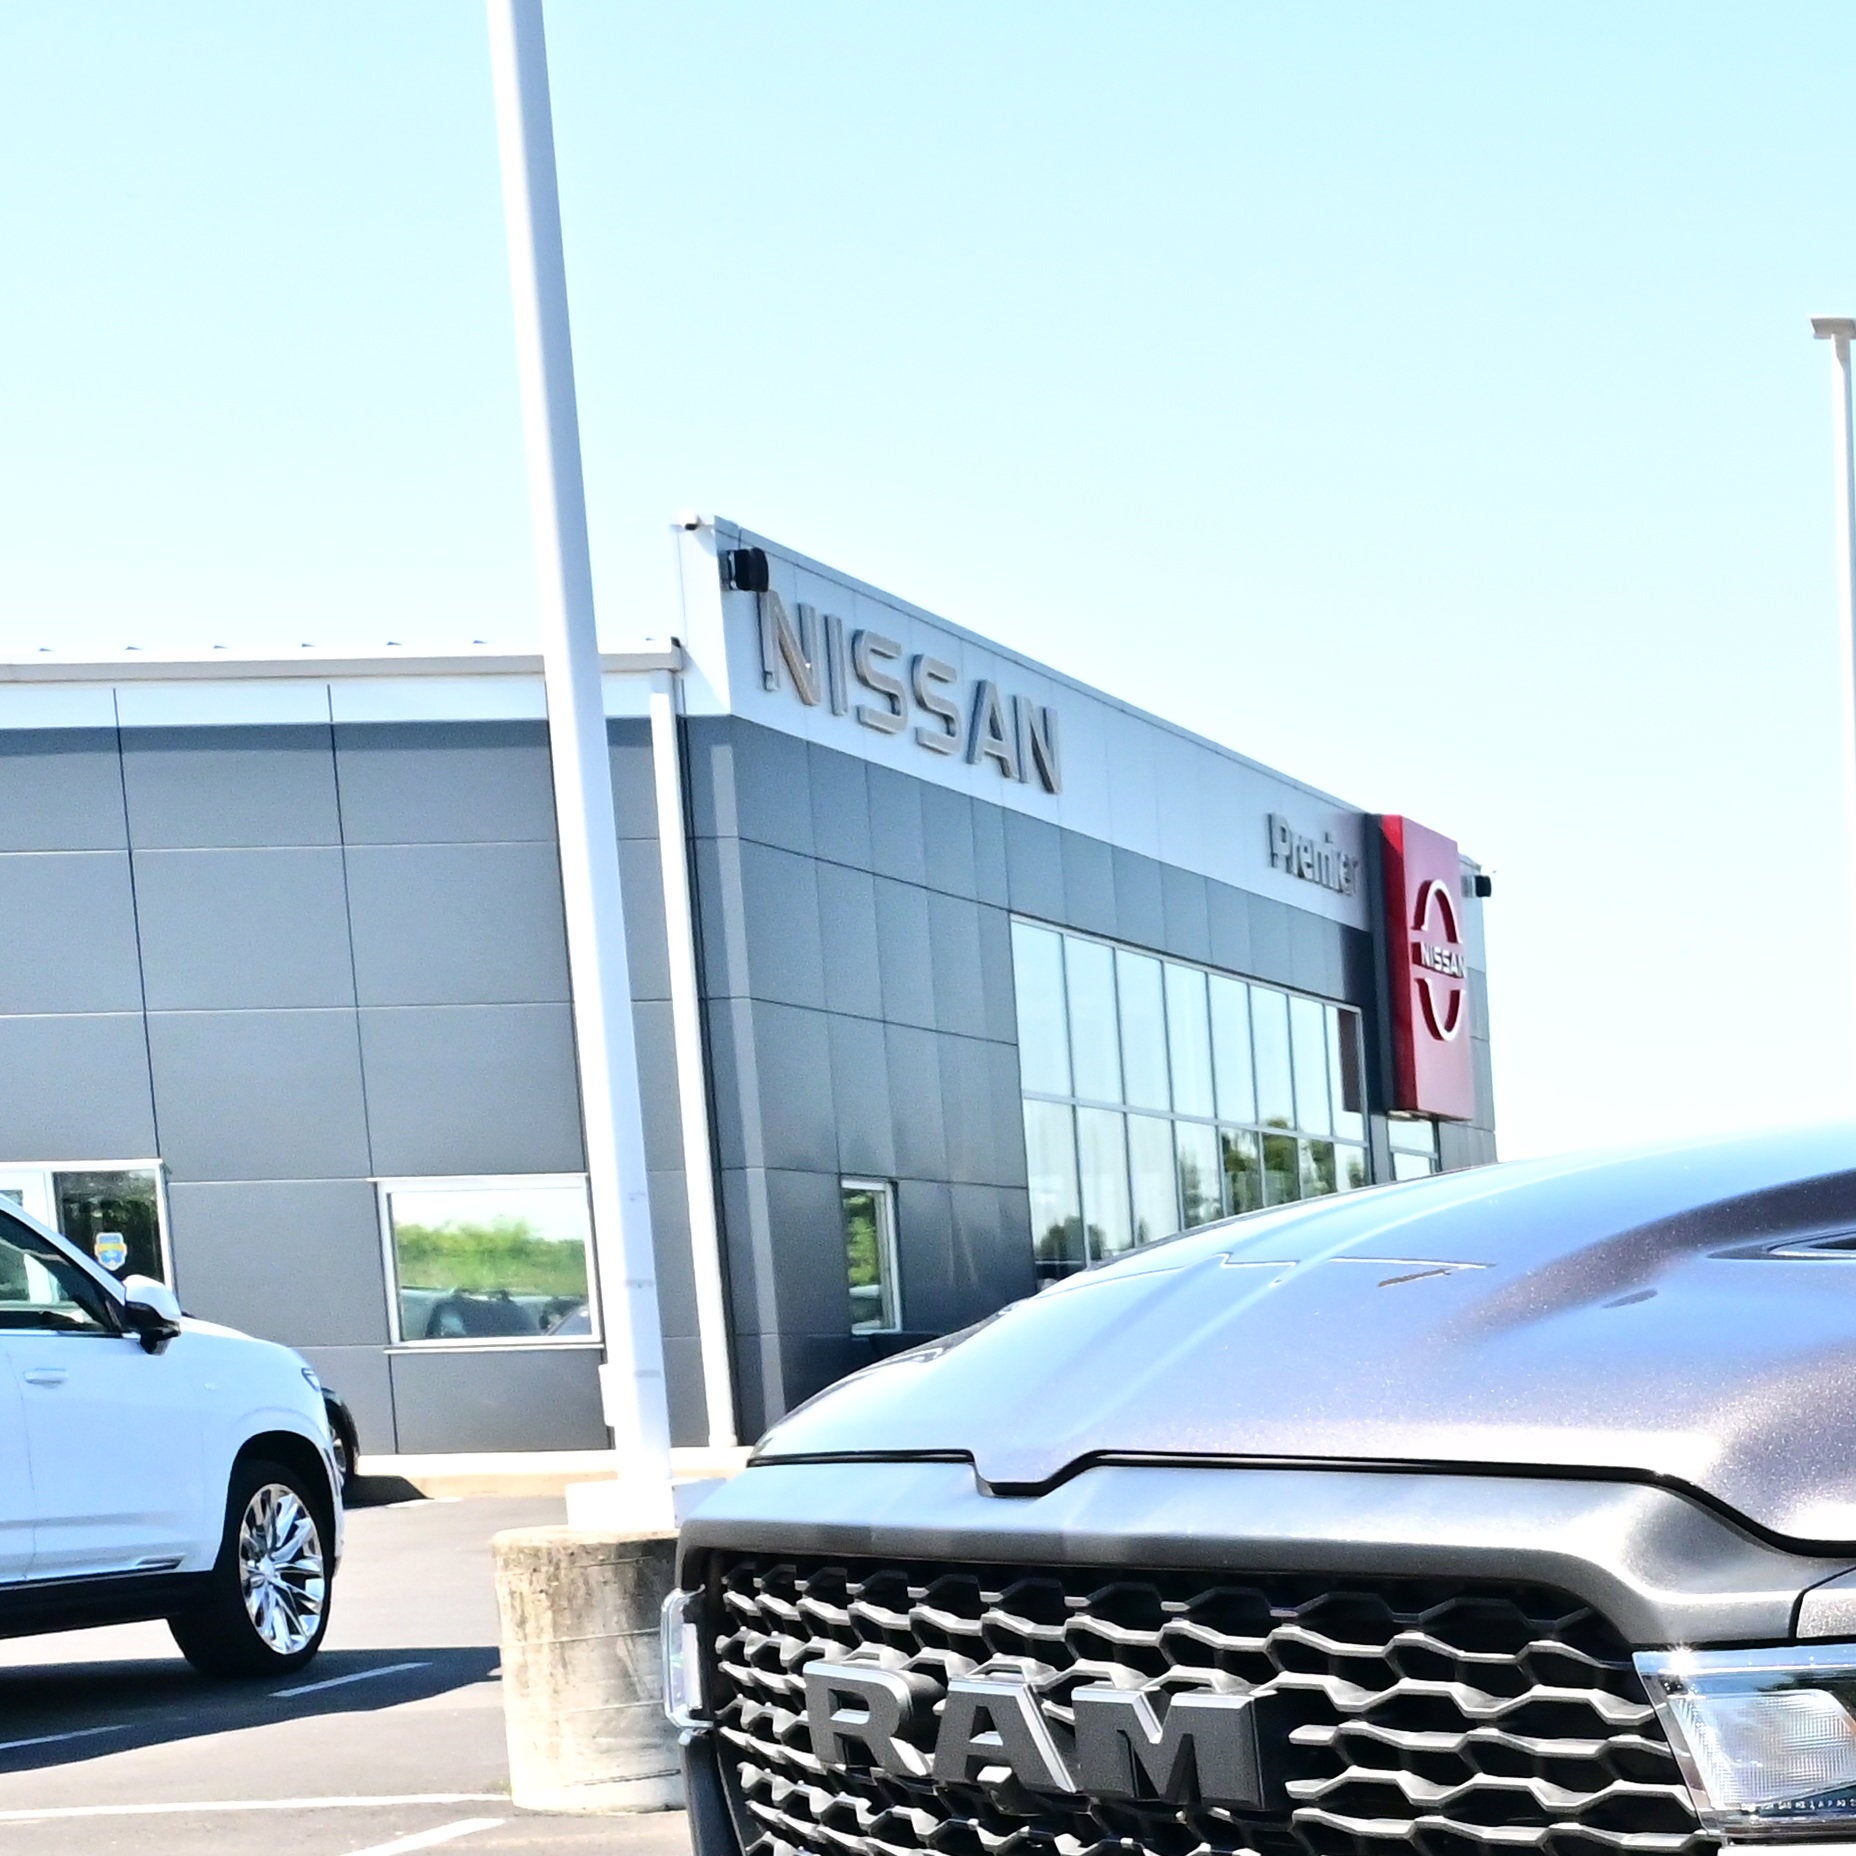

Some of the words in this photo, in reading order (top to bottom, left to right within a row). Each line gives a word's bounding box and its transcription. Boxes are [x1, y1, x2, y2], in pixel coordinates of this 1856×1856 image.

[757, 590, 1062, 794] NISSAN
[1267, 813, 1360, 897] Premier
[1420, 942, 1467, 979] NISSAN
[803, 1661, 1266, 1808] RAM
